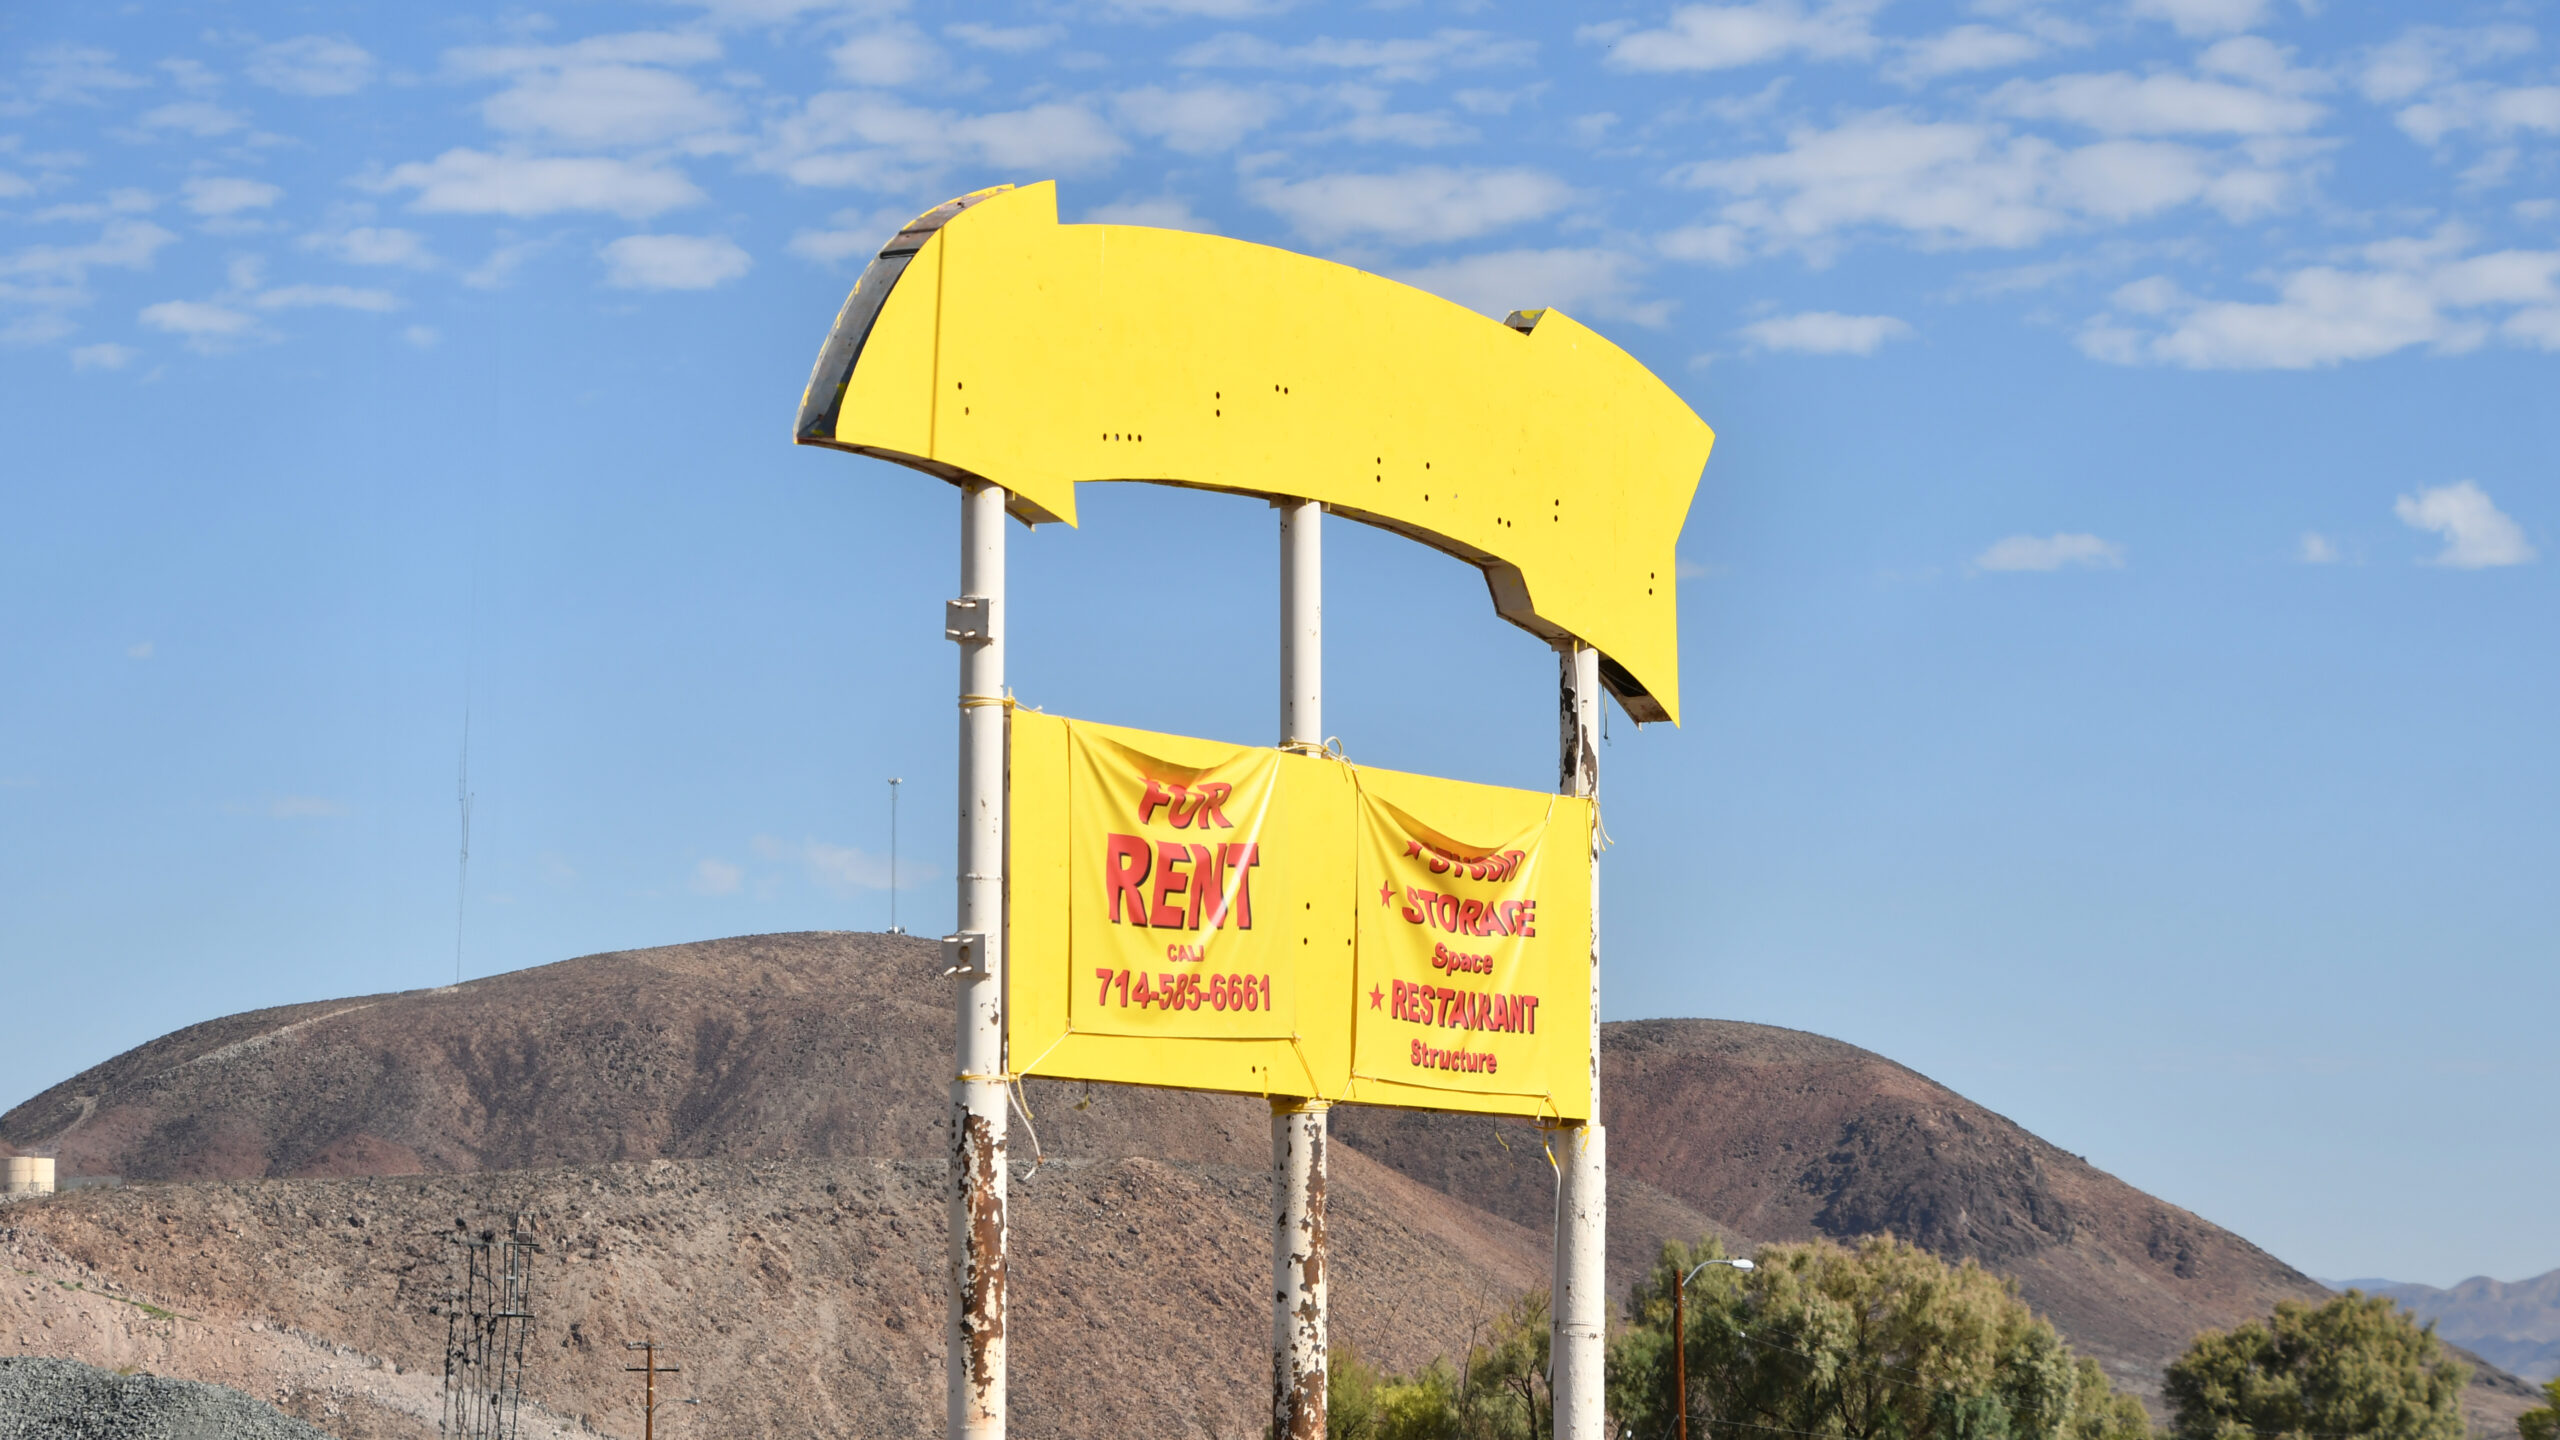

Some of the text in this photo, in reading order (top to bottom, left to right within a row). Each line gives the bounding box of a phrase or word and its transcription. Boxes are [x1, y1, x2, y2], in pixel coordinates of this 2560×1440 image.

[1137, 776, 1233, 829] FOR
[1105, 832, 1260, 930] RENT
[1401, 885, 1536, 937] STORAGE
[1432, 941, 1493, 976] Space
[1095, 967, 1271, 1012] 714-585-6661
[1410, 1038, 1497, 1073] Structure
